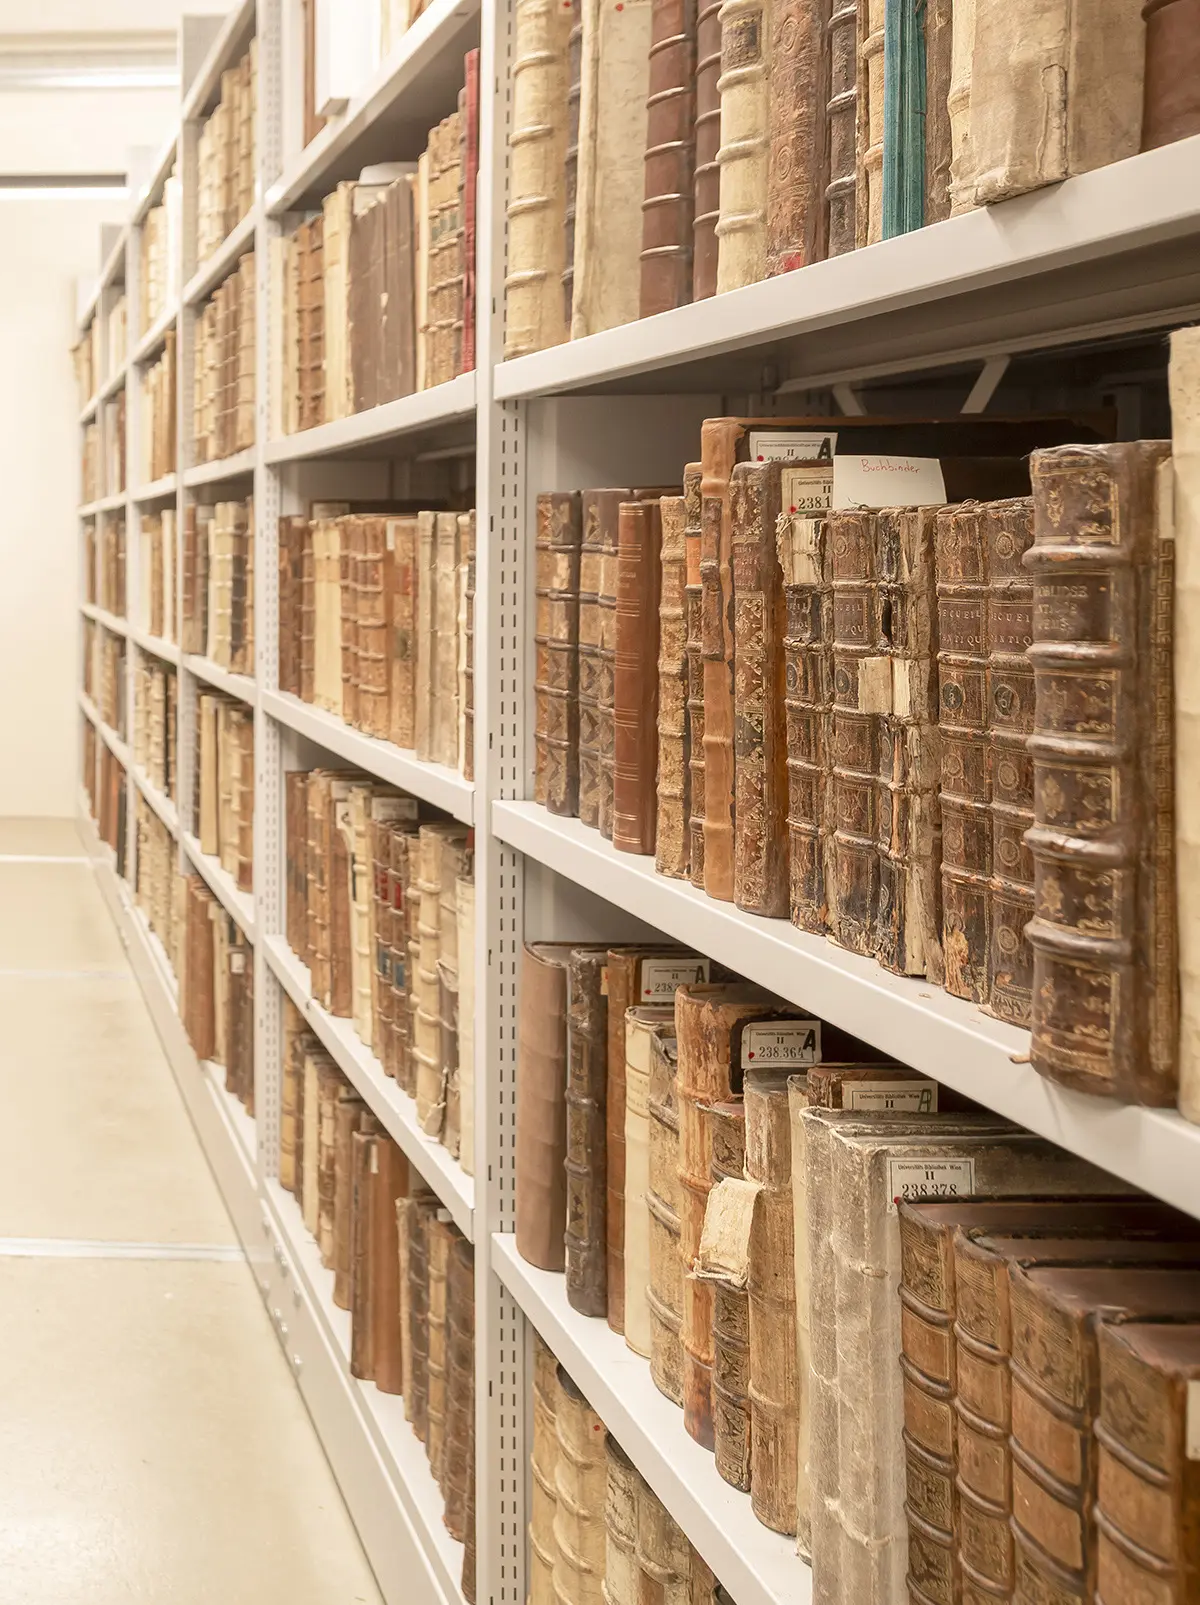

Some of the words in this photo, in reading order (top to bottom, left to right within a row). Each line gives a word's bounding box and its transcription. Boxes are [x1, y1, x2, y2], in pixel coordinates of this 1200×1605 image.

[817, 437, 832, 459] A
[861, 458, 920, 473] Buchbinder
[695, 965, 707, 984] A
[803, 1029, 816, 1051] A
